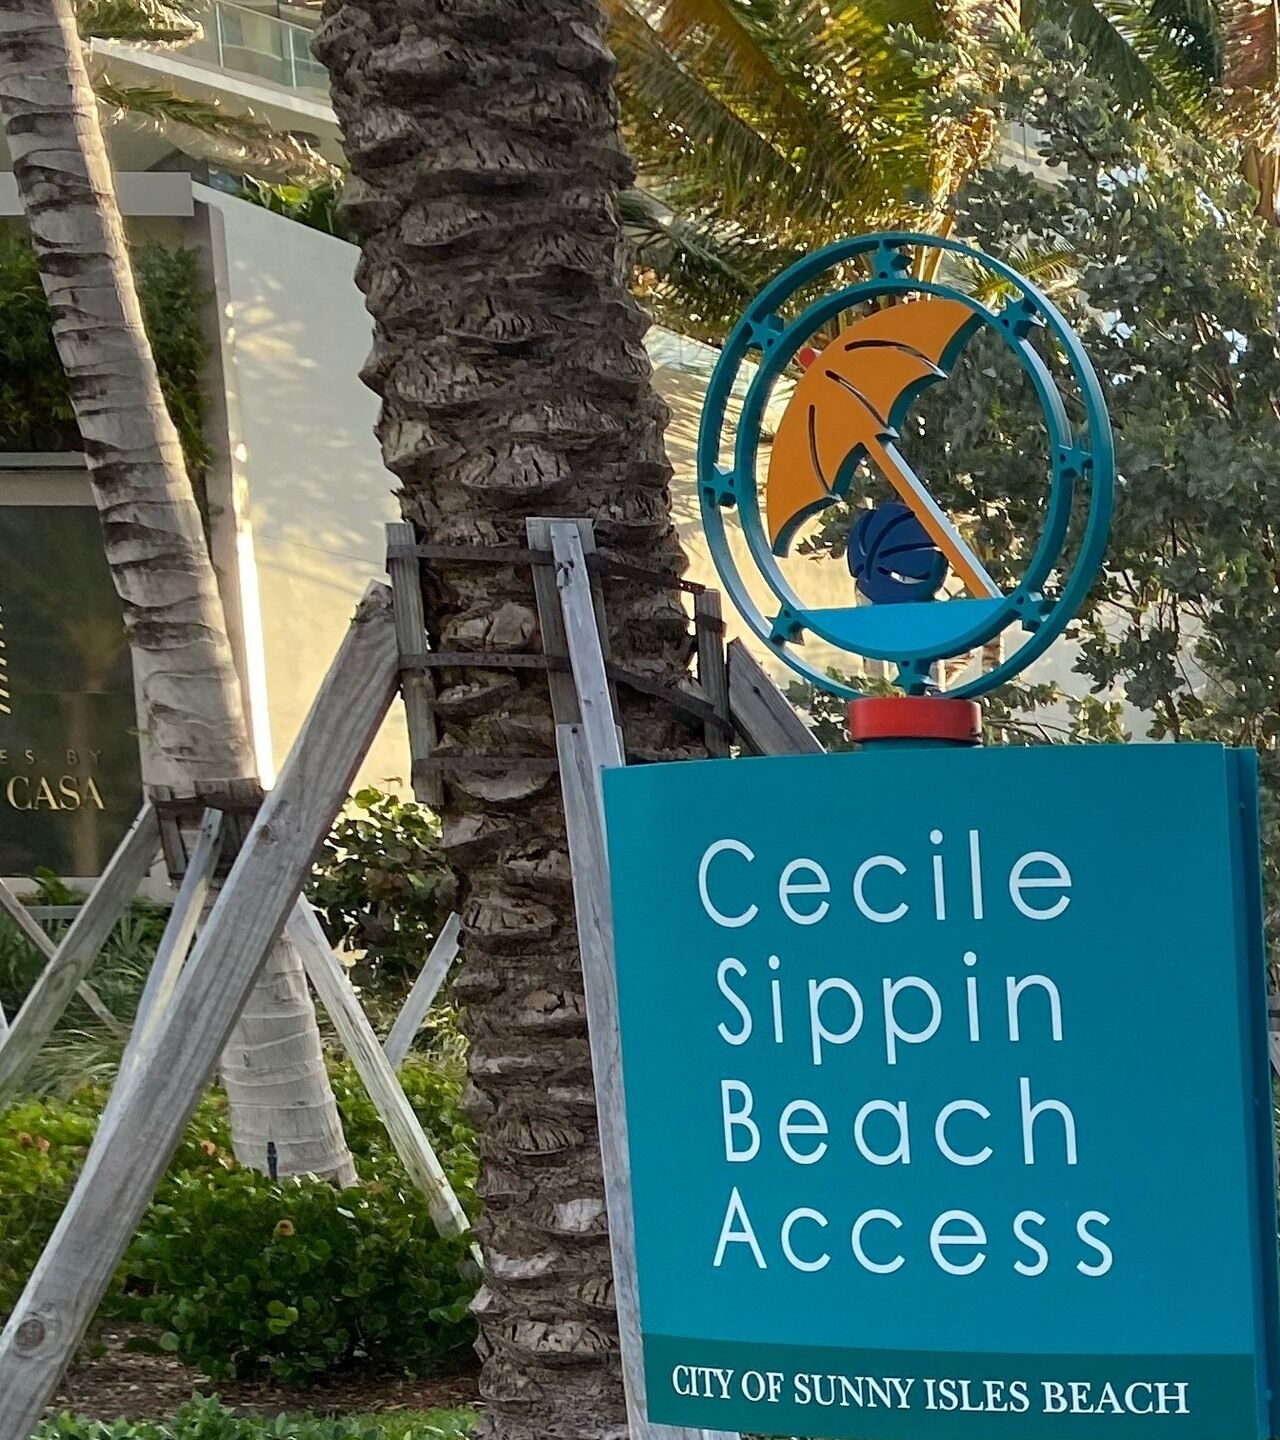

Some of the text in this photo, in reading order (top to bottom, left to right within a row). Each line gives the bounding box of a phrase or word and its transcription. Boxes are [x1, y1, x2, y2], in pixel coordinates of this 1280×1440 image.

[7, 775, 105, 811] CASA
[66, 748, 101, 765] BY
[698, 829, 1073, 928] Cecile
[716, 951, 1064, 1065] Sippin
[720, 1077, 1077, 1166] Beach
[712, 1186, 1114, 1277] Access
[672, 1364, 1190, 1414] CITY OF SUNNY ISLES BEACH
